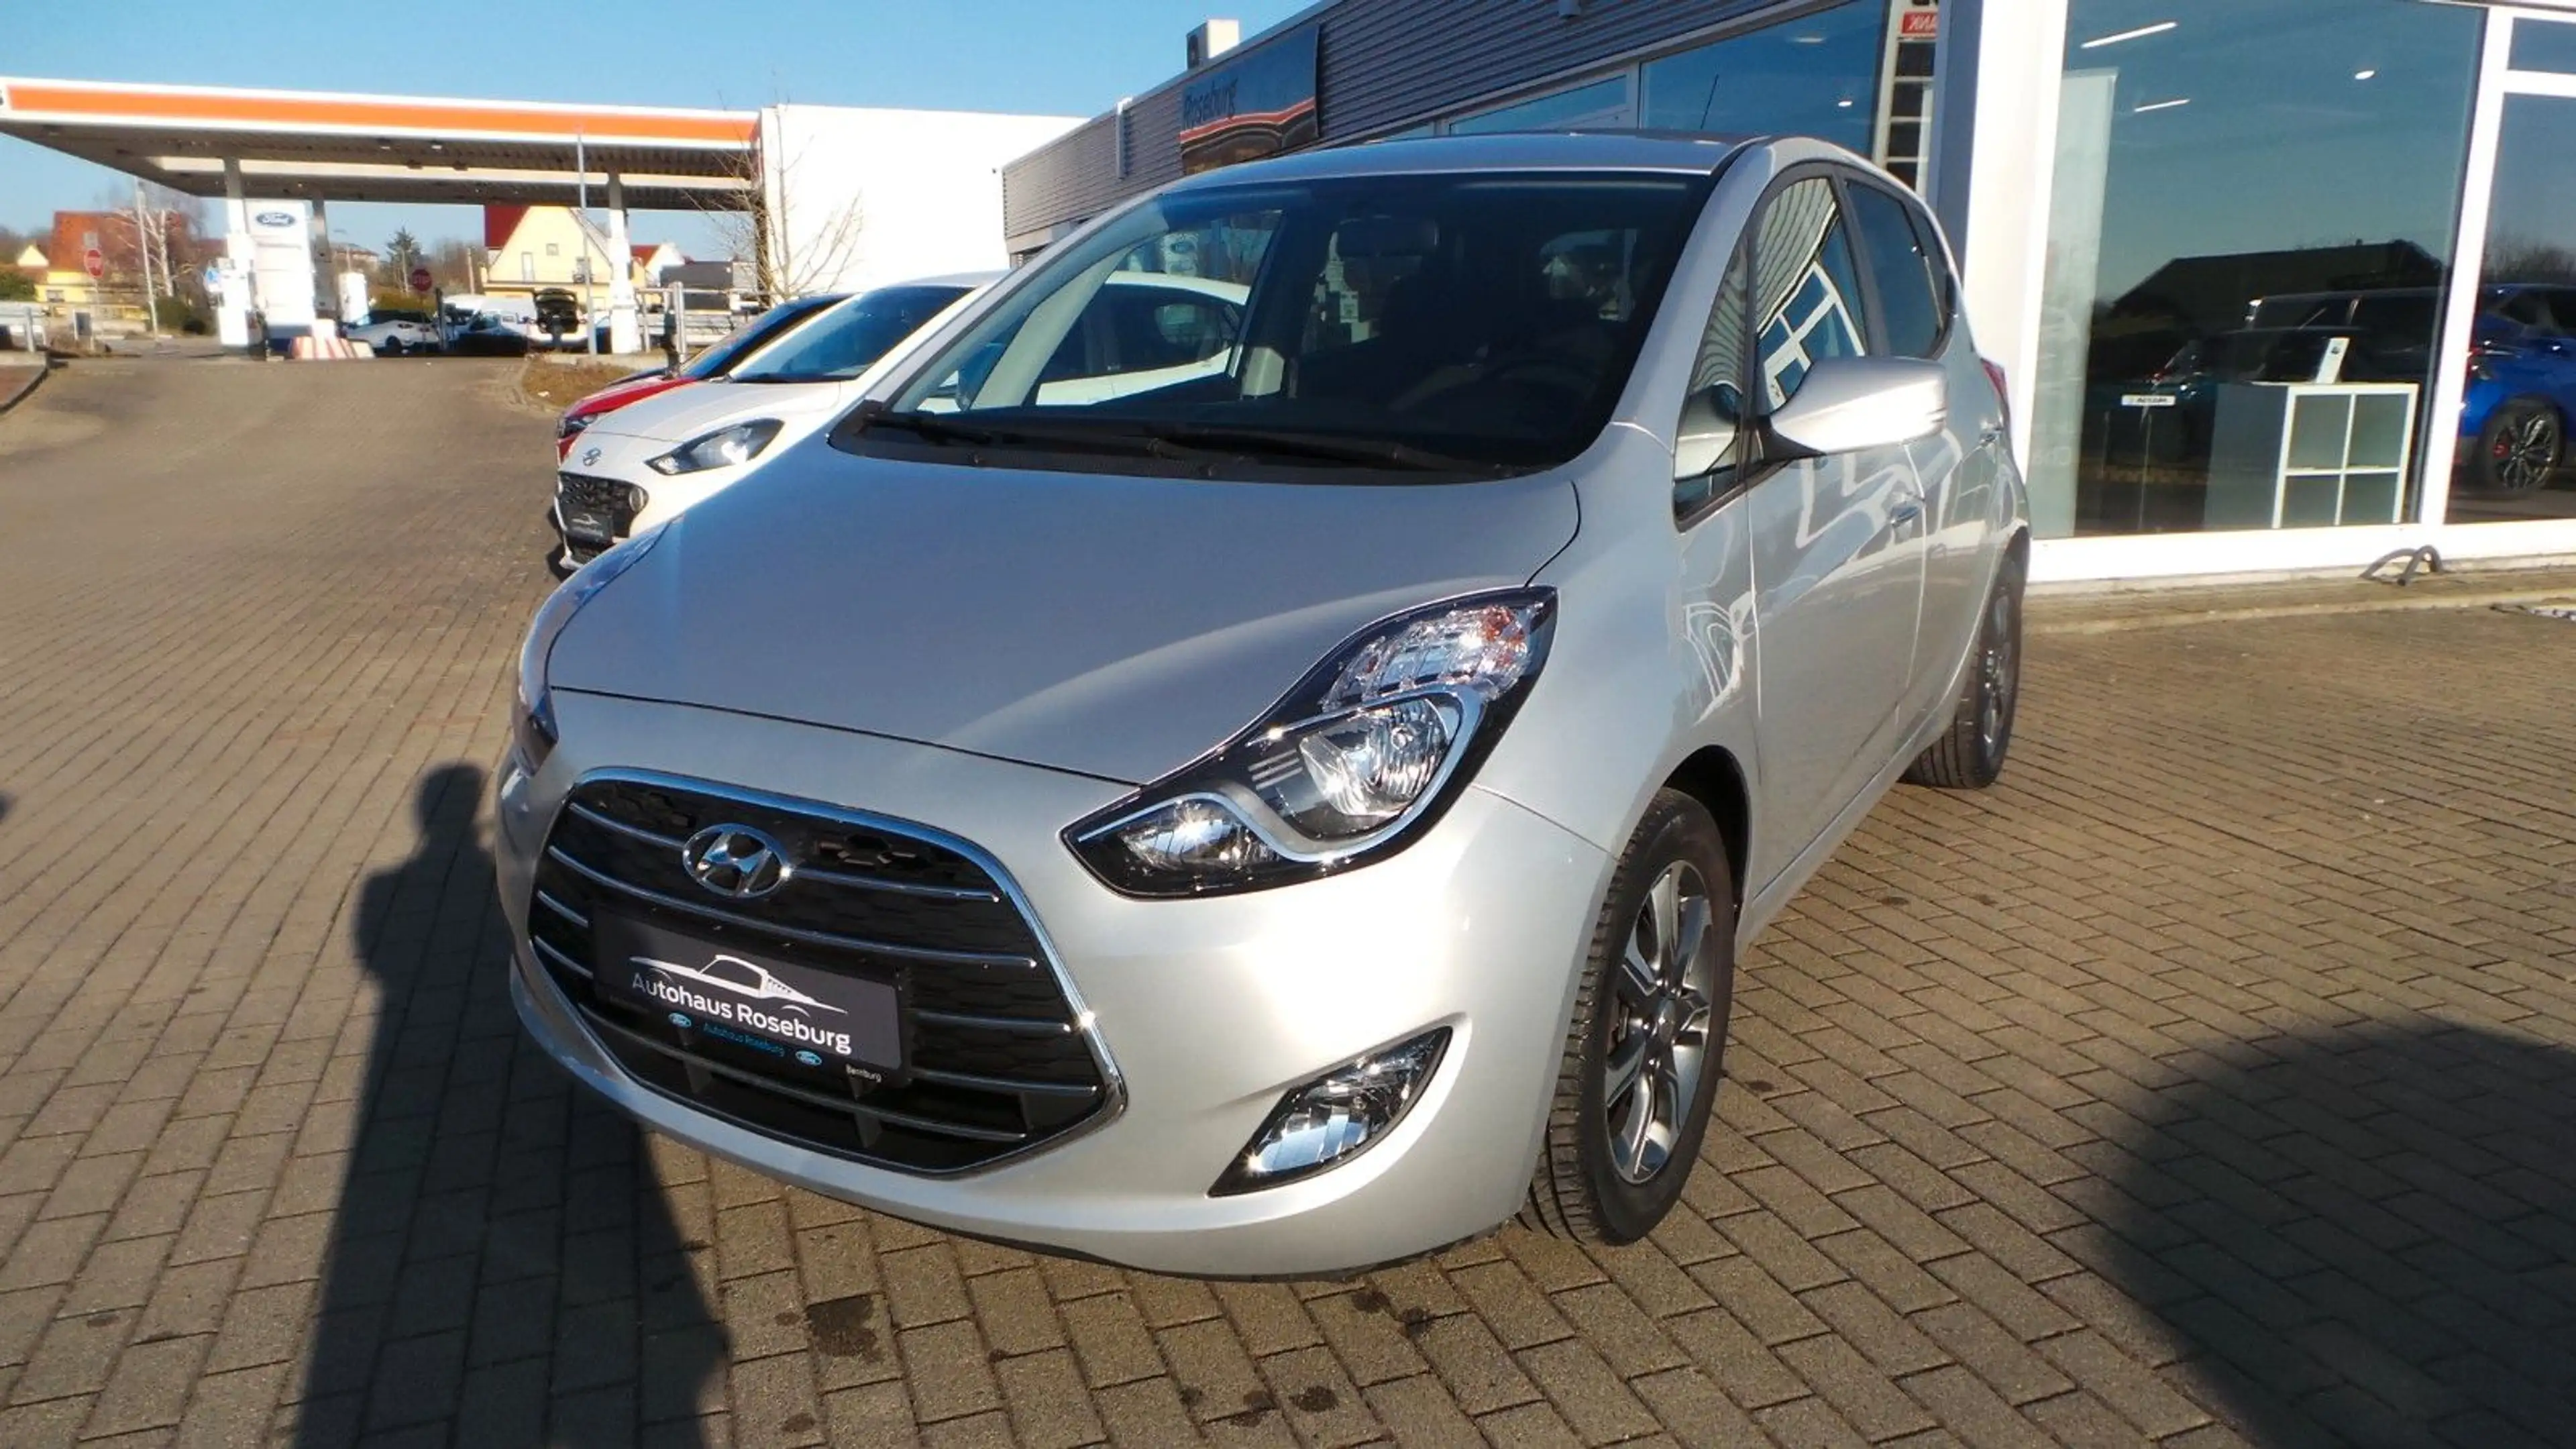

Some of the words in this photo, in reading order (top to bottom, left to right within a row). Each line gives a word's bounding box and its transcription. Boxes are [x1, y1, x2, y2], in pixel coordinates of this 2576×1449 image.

[632, 973, 733, 1019] Autohaus
[738, 1004, 852, 1055] Roseburg
[703, 1022, 743, 1043] Autohaus
[745, 1034, 785, 1057] Roseburg
